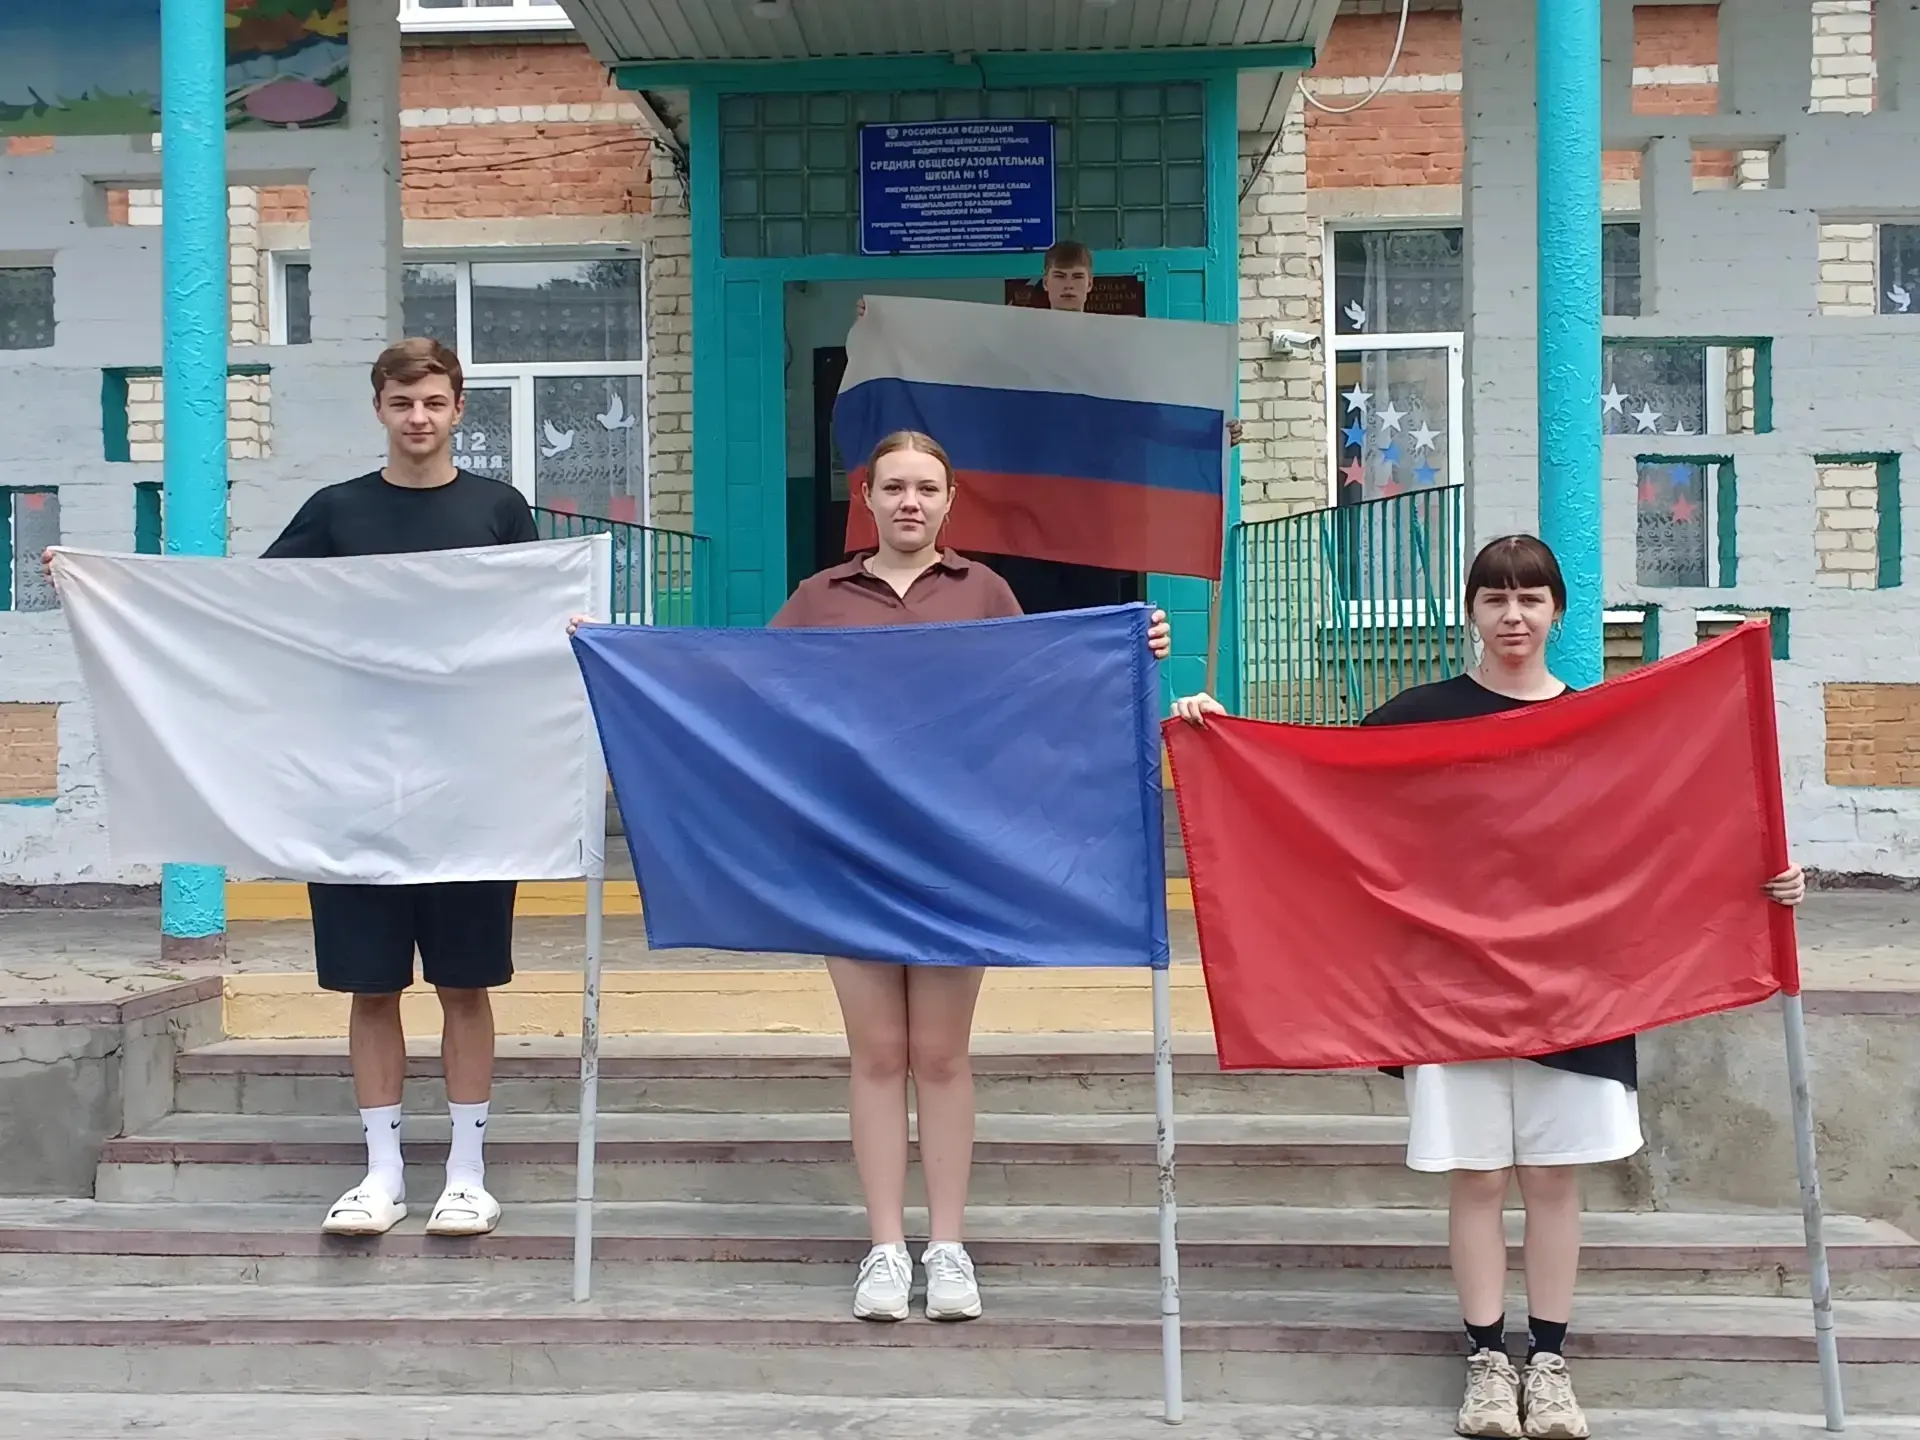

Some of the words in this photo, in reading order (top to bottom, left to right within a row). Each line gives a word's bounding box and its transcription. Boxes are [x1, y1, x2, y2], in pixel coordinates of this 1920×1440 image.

[902, 126, 959, 137] РОССИЙСКАЯ
[961, 125, 1014, 134] ФЕДЕРАЦИЯ
[870, 160, 916, 171] СРЕДНЯЯ
[918, 156, 1045, 168] ОБЩЕОБРАЗОВАТЕЛЬНАЯ
[925, 170, 961, 181] ШКОЛА
[963, 170, 975, 179] №
[977, 169, 989, 179] 15
[453, 431, 487, 451] 12
[452, 455, 503, 470] ЮНЯ
